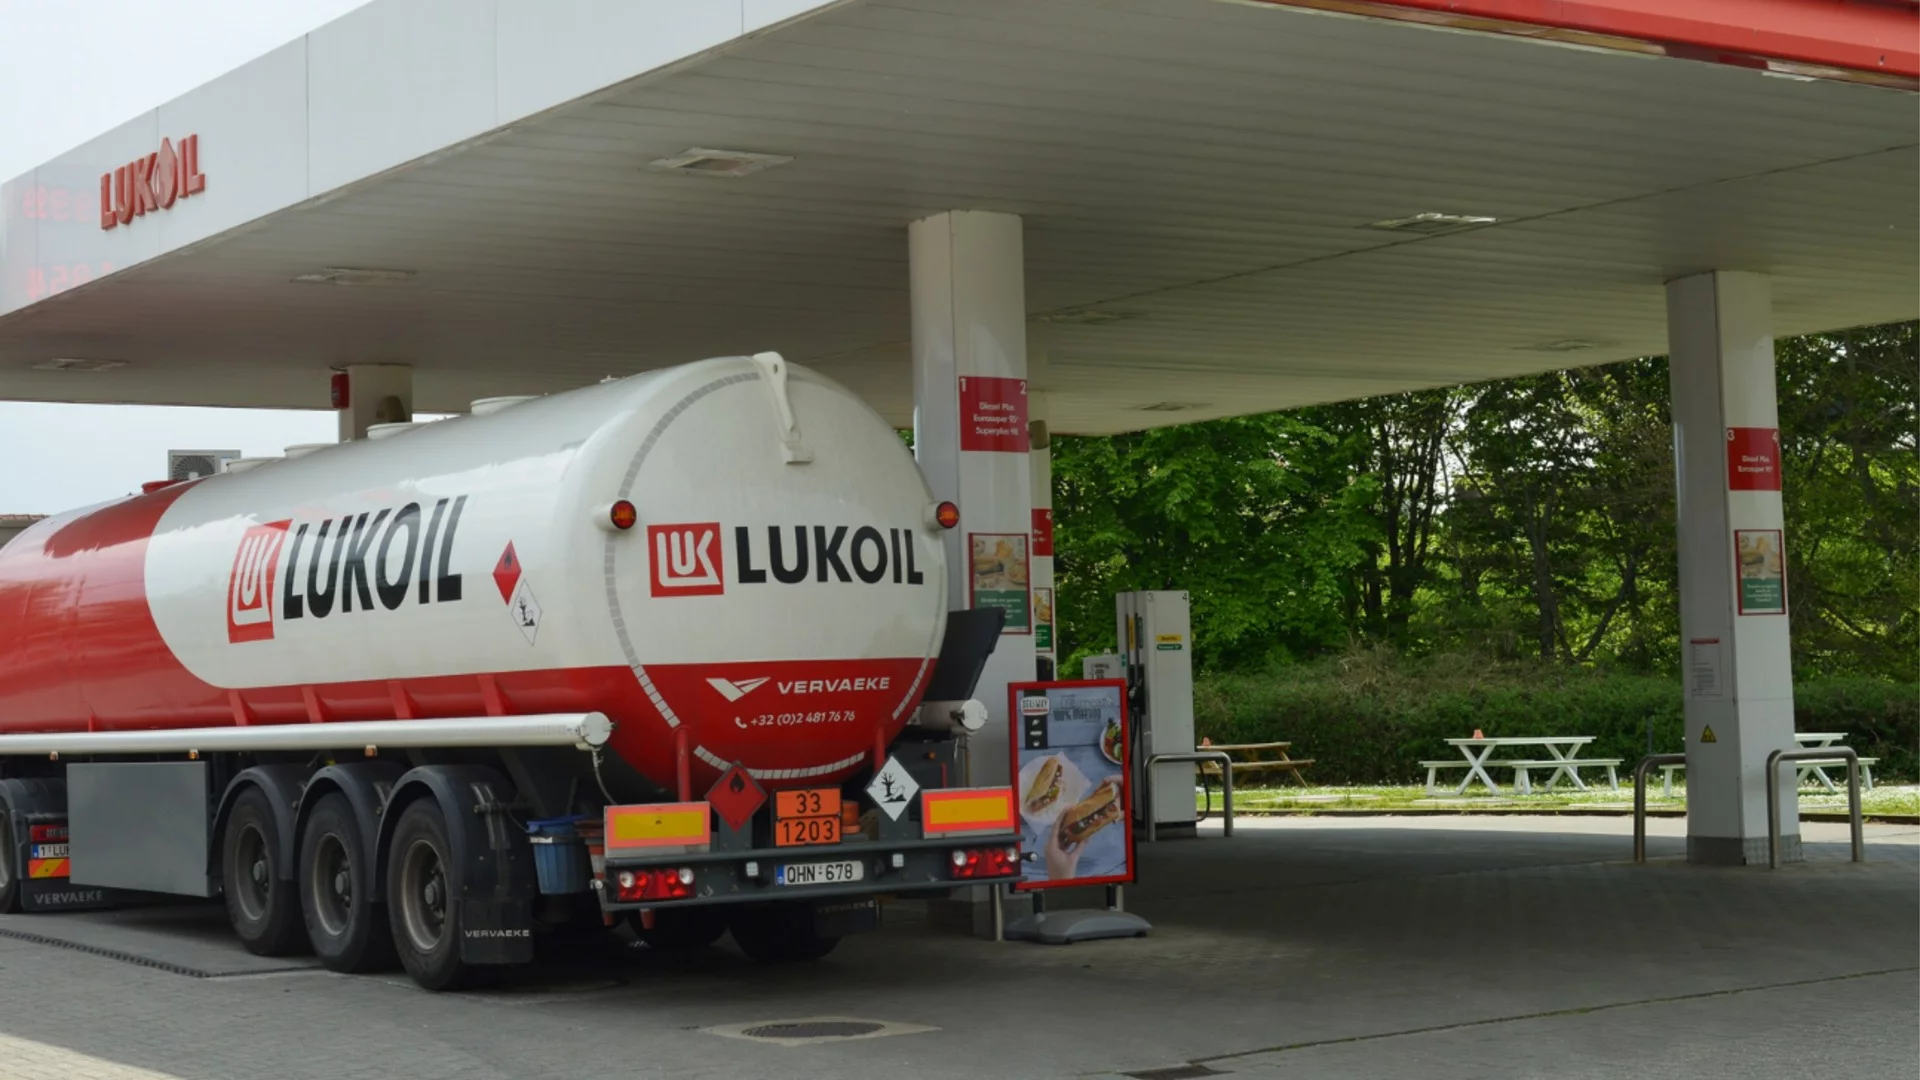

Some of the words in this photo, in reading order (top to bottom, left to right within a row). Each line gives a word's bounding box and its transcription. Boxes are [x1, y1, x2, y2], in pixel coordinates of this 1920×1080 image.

[100, 134, 206, 231] LUKOIL
[960, 378, 967, 392] 1
[1020, 381, 1027, 395] 2
[283, 495, 468, 620] LUKOIL
[656, 529, 721, 588] LUK
[735, 525, 924, 585] LUKOIL
[777, 677, 890, 695] VERVAEKE
[751, 714, 774, 726] +32
[776, 712, 804, 726] (0)2
[805, 712, 826, 723] 481
[828, 710, 841, 722] 76
[843, 710, 855, 721] 76
[796, 793, 821, 814] 33
[783, 820, 834, 843] 1203
[34, 890, 102, 905] VERVAEKE
[465, 929, 530, 938] VERVAEKE
